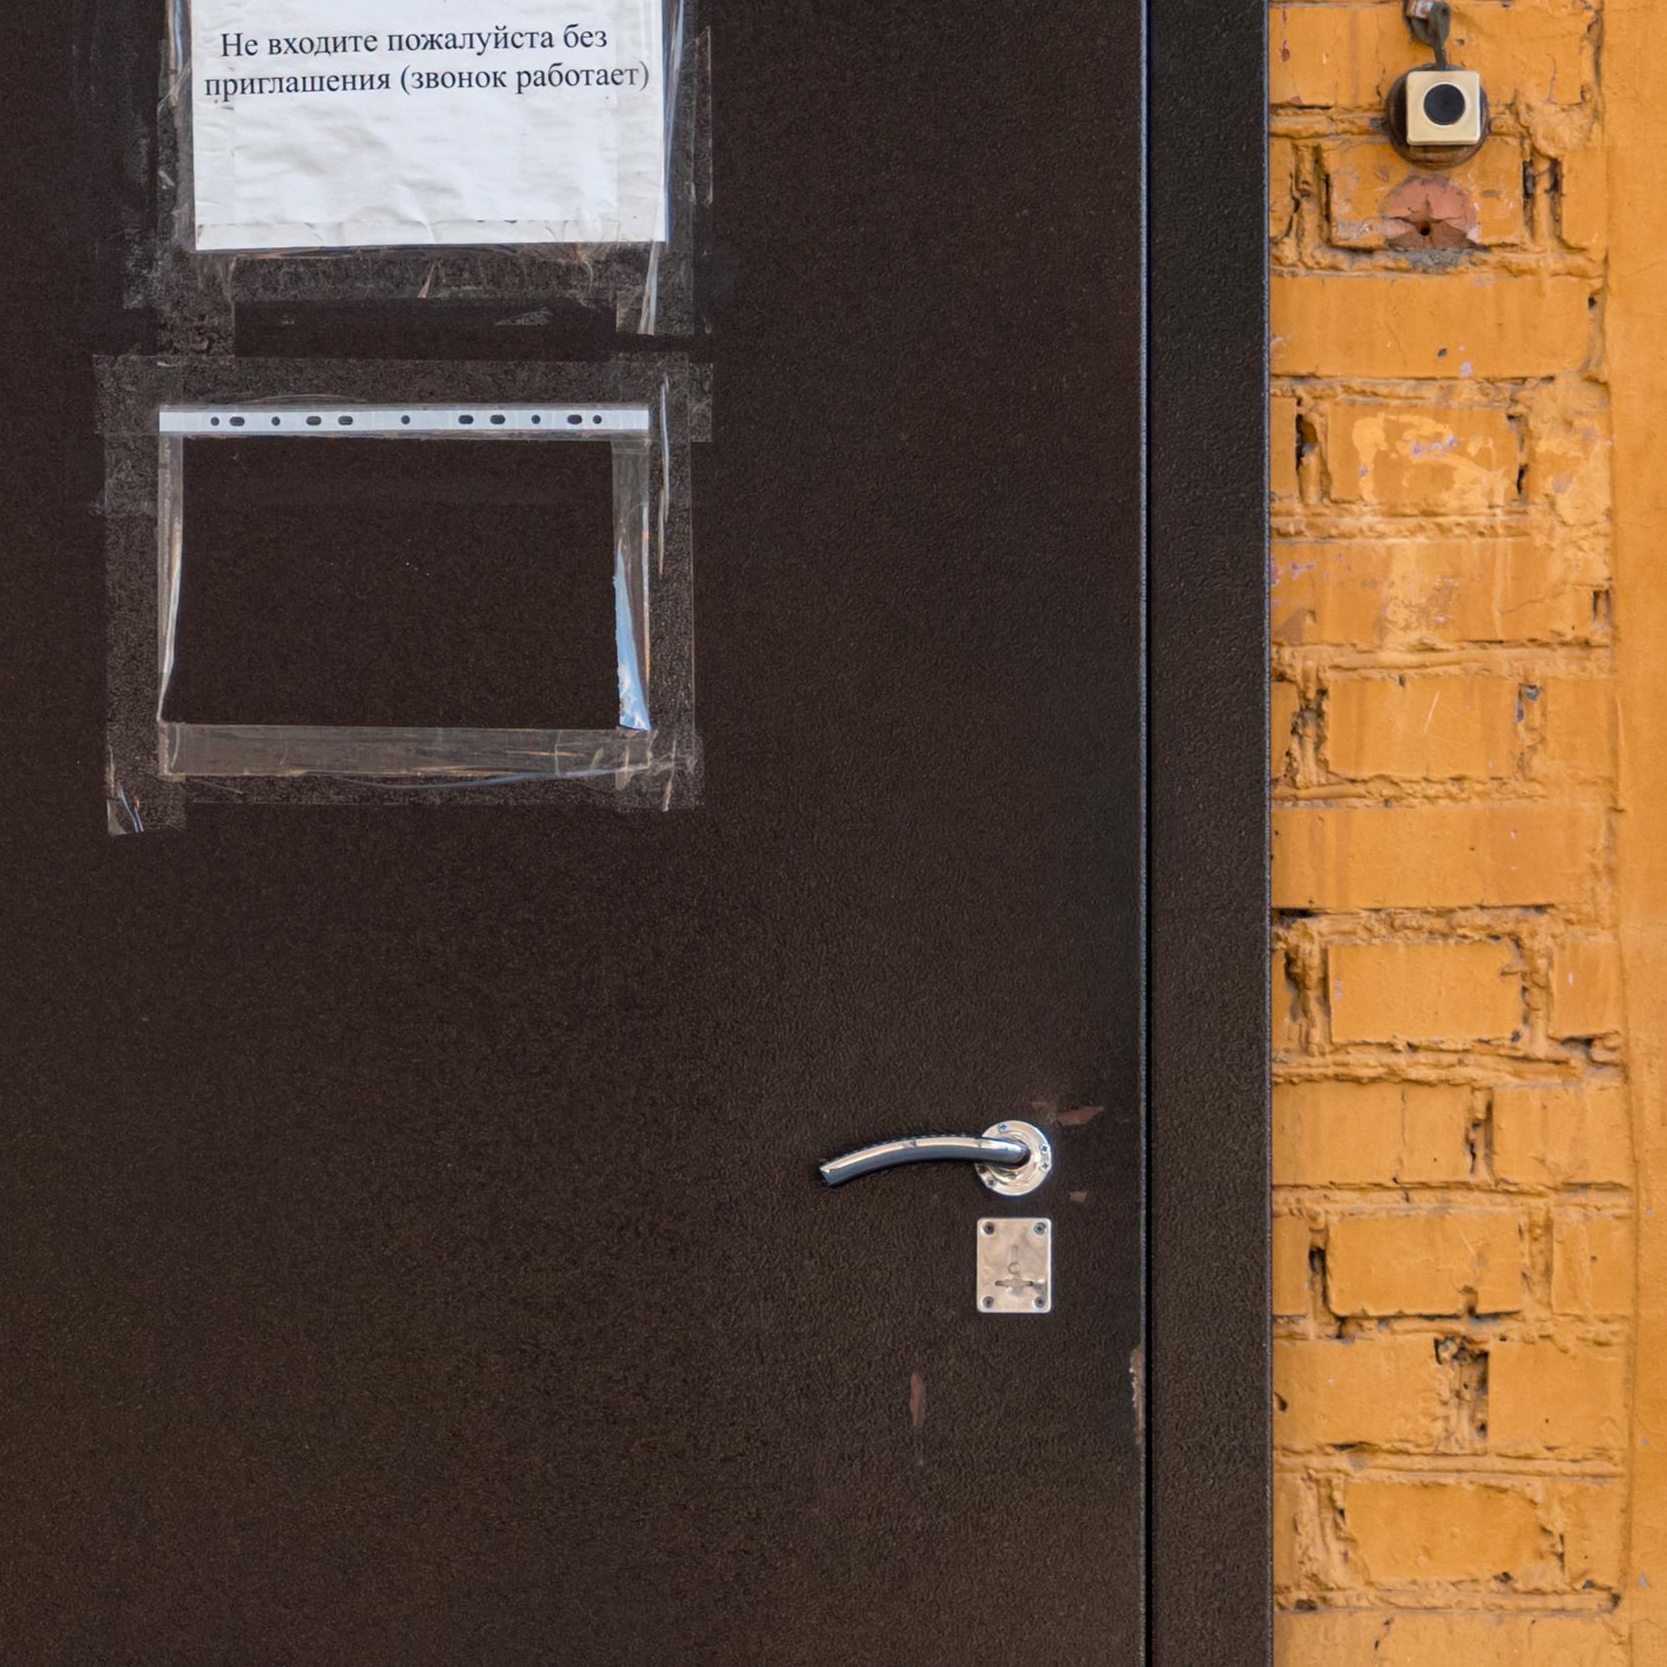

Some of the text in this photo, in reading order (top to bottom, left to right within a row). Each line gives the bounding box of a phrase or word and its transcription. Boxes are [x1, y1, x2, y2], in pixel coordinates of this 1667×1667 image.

[221, 23, 608, 57] Не входите пожалуйста без
[205, 60, 650, 99] приглашения (звонок работает)
